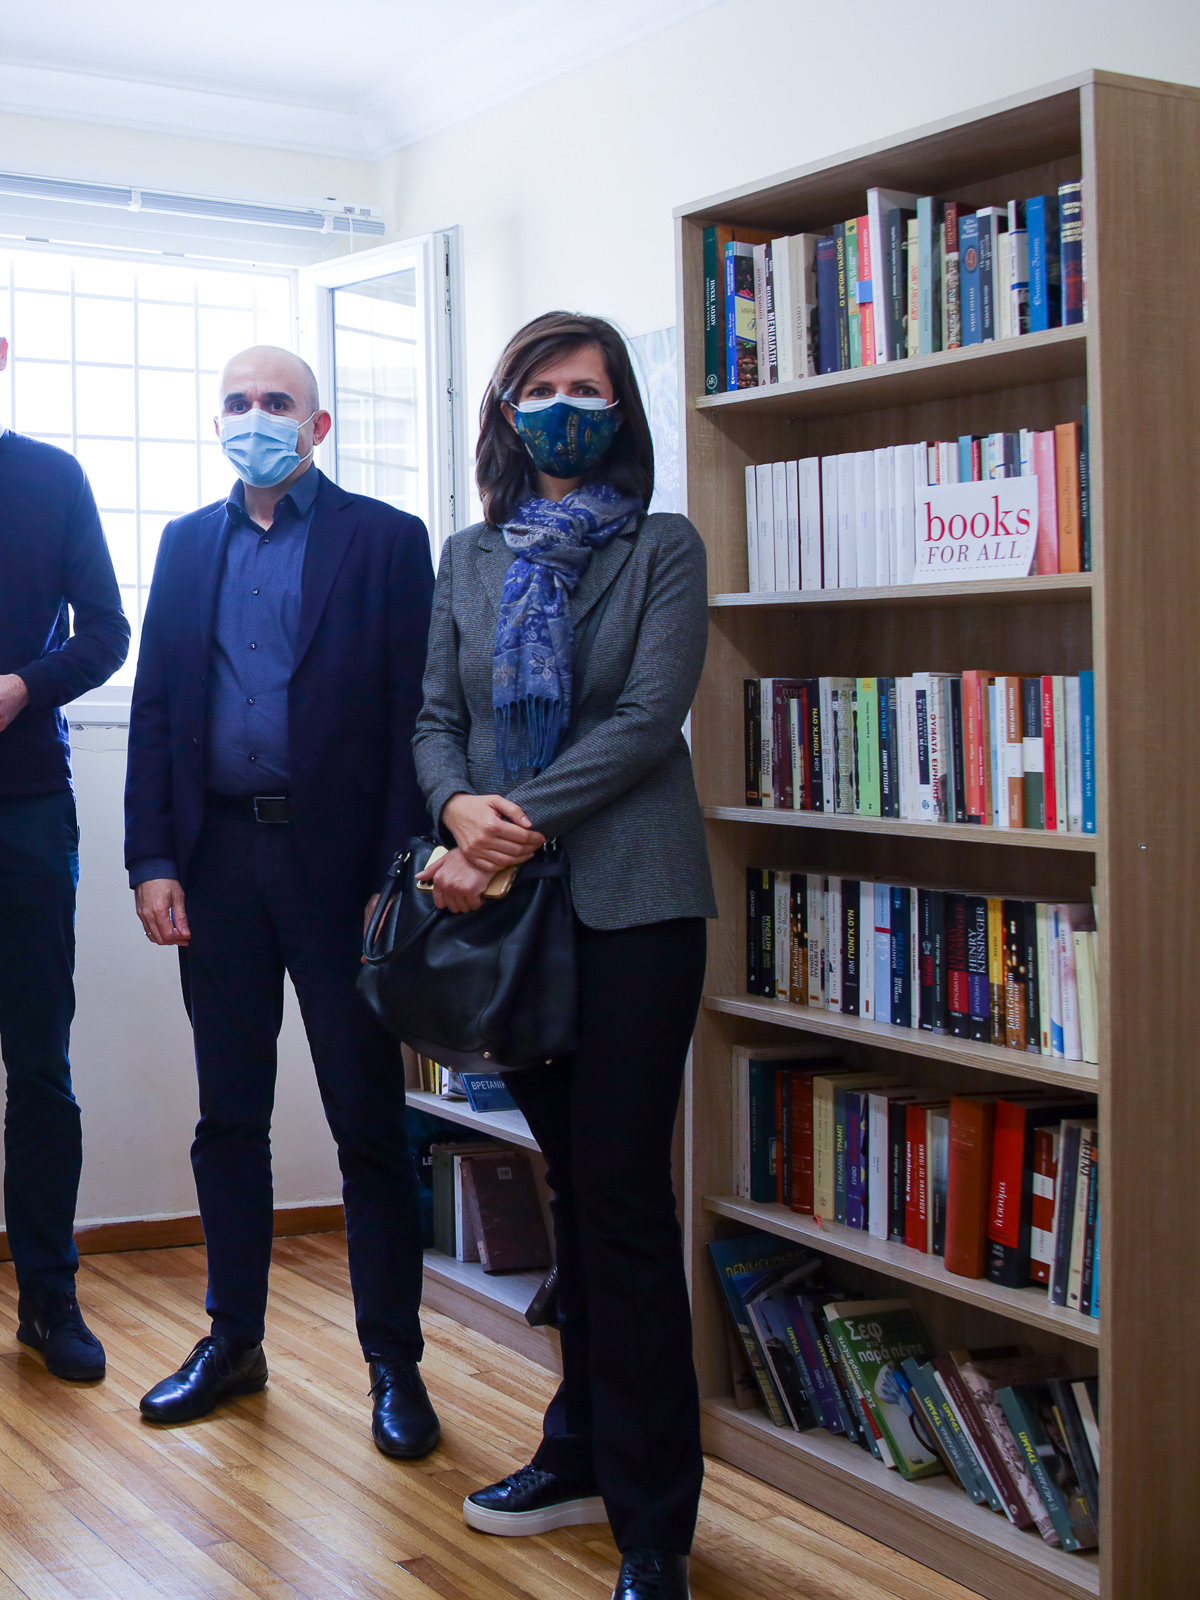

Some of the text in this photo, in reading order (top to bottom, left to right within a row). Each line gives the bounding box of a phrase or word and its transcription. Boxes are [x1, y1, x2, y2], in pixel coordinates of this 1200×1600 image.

[923, 494, 1031, 542] books
[927, 540, 1022, 565] FOR ALL
[976, 906, 986, 974] KISSINGER
